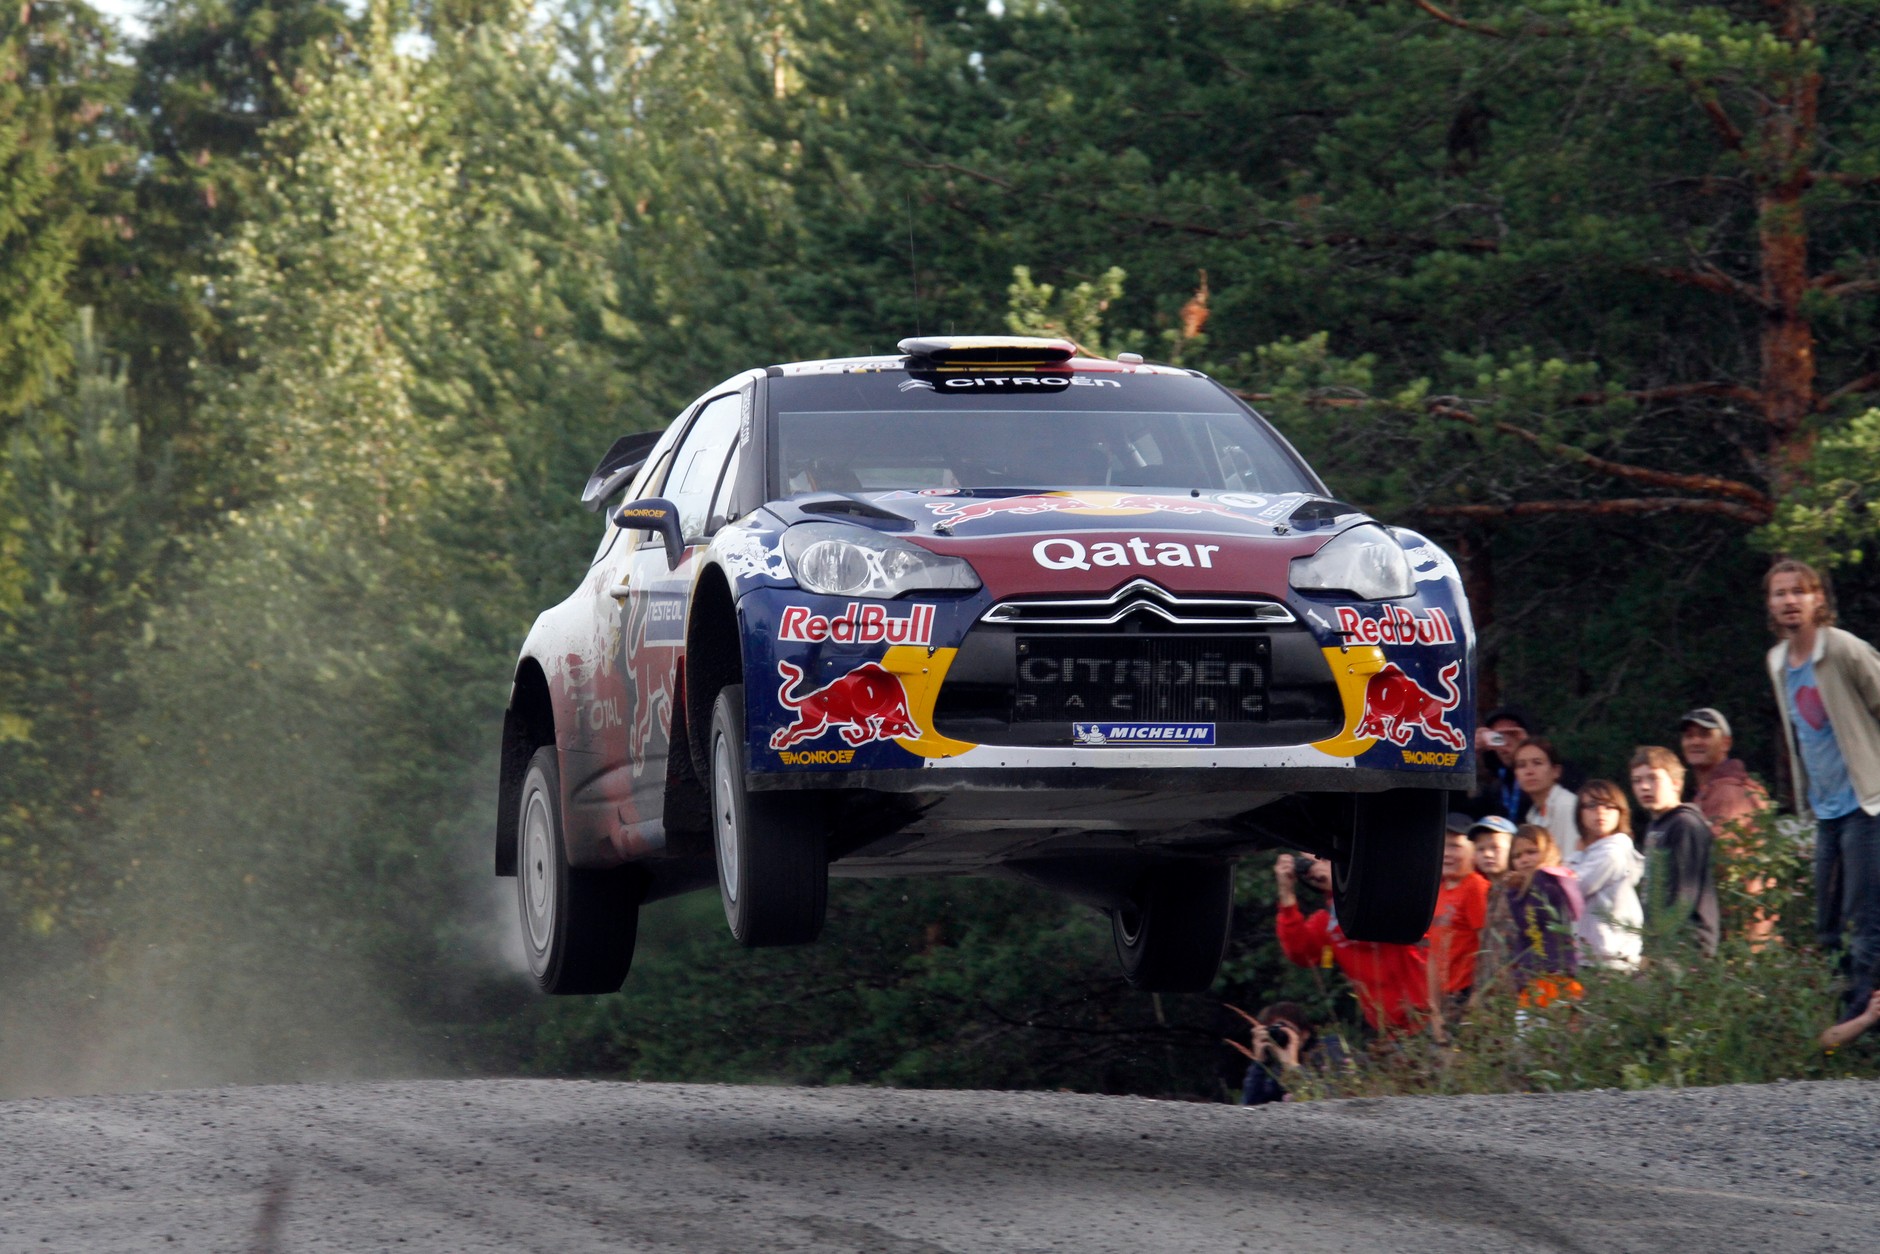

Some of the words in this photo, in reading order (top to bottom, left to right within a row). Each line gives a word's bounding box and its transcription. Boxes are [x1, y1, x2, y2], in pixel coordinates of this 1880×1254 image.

[945, 376, 1122, 388] CITROËN
[626, 508, 663, 518] MONROE
[1032, 537, 1220, 571] Qatar
[780, 603, 858, 642] Red
[859, 605, 935, 643] Bull
[1336, 604, 1397, 643] Red
[1395, 606, 1455, 644] Bull
[1020, 653, 1264, 687] CITROËN
[1109, 727, 1209, 740] MICHELIN
[788, 750, 848, 765] MONROE
[1408, 751, 1453, 767] MONROE
